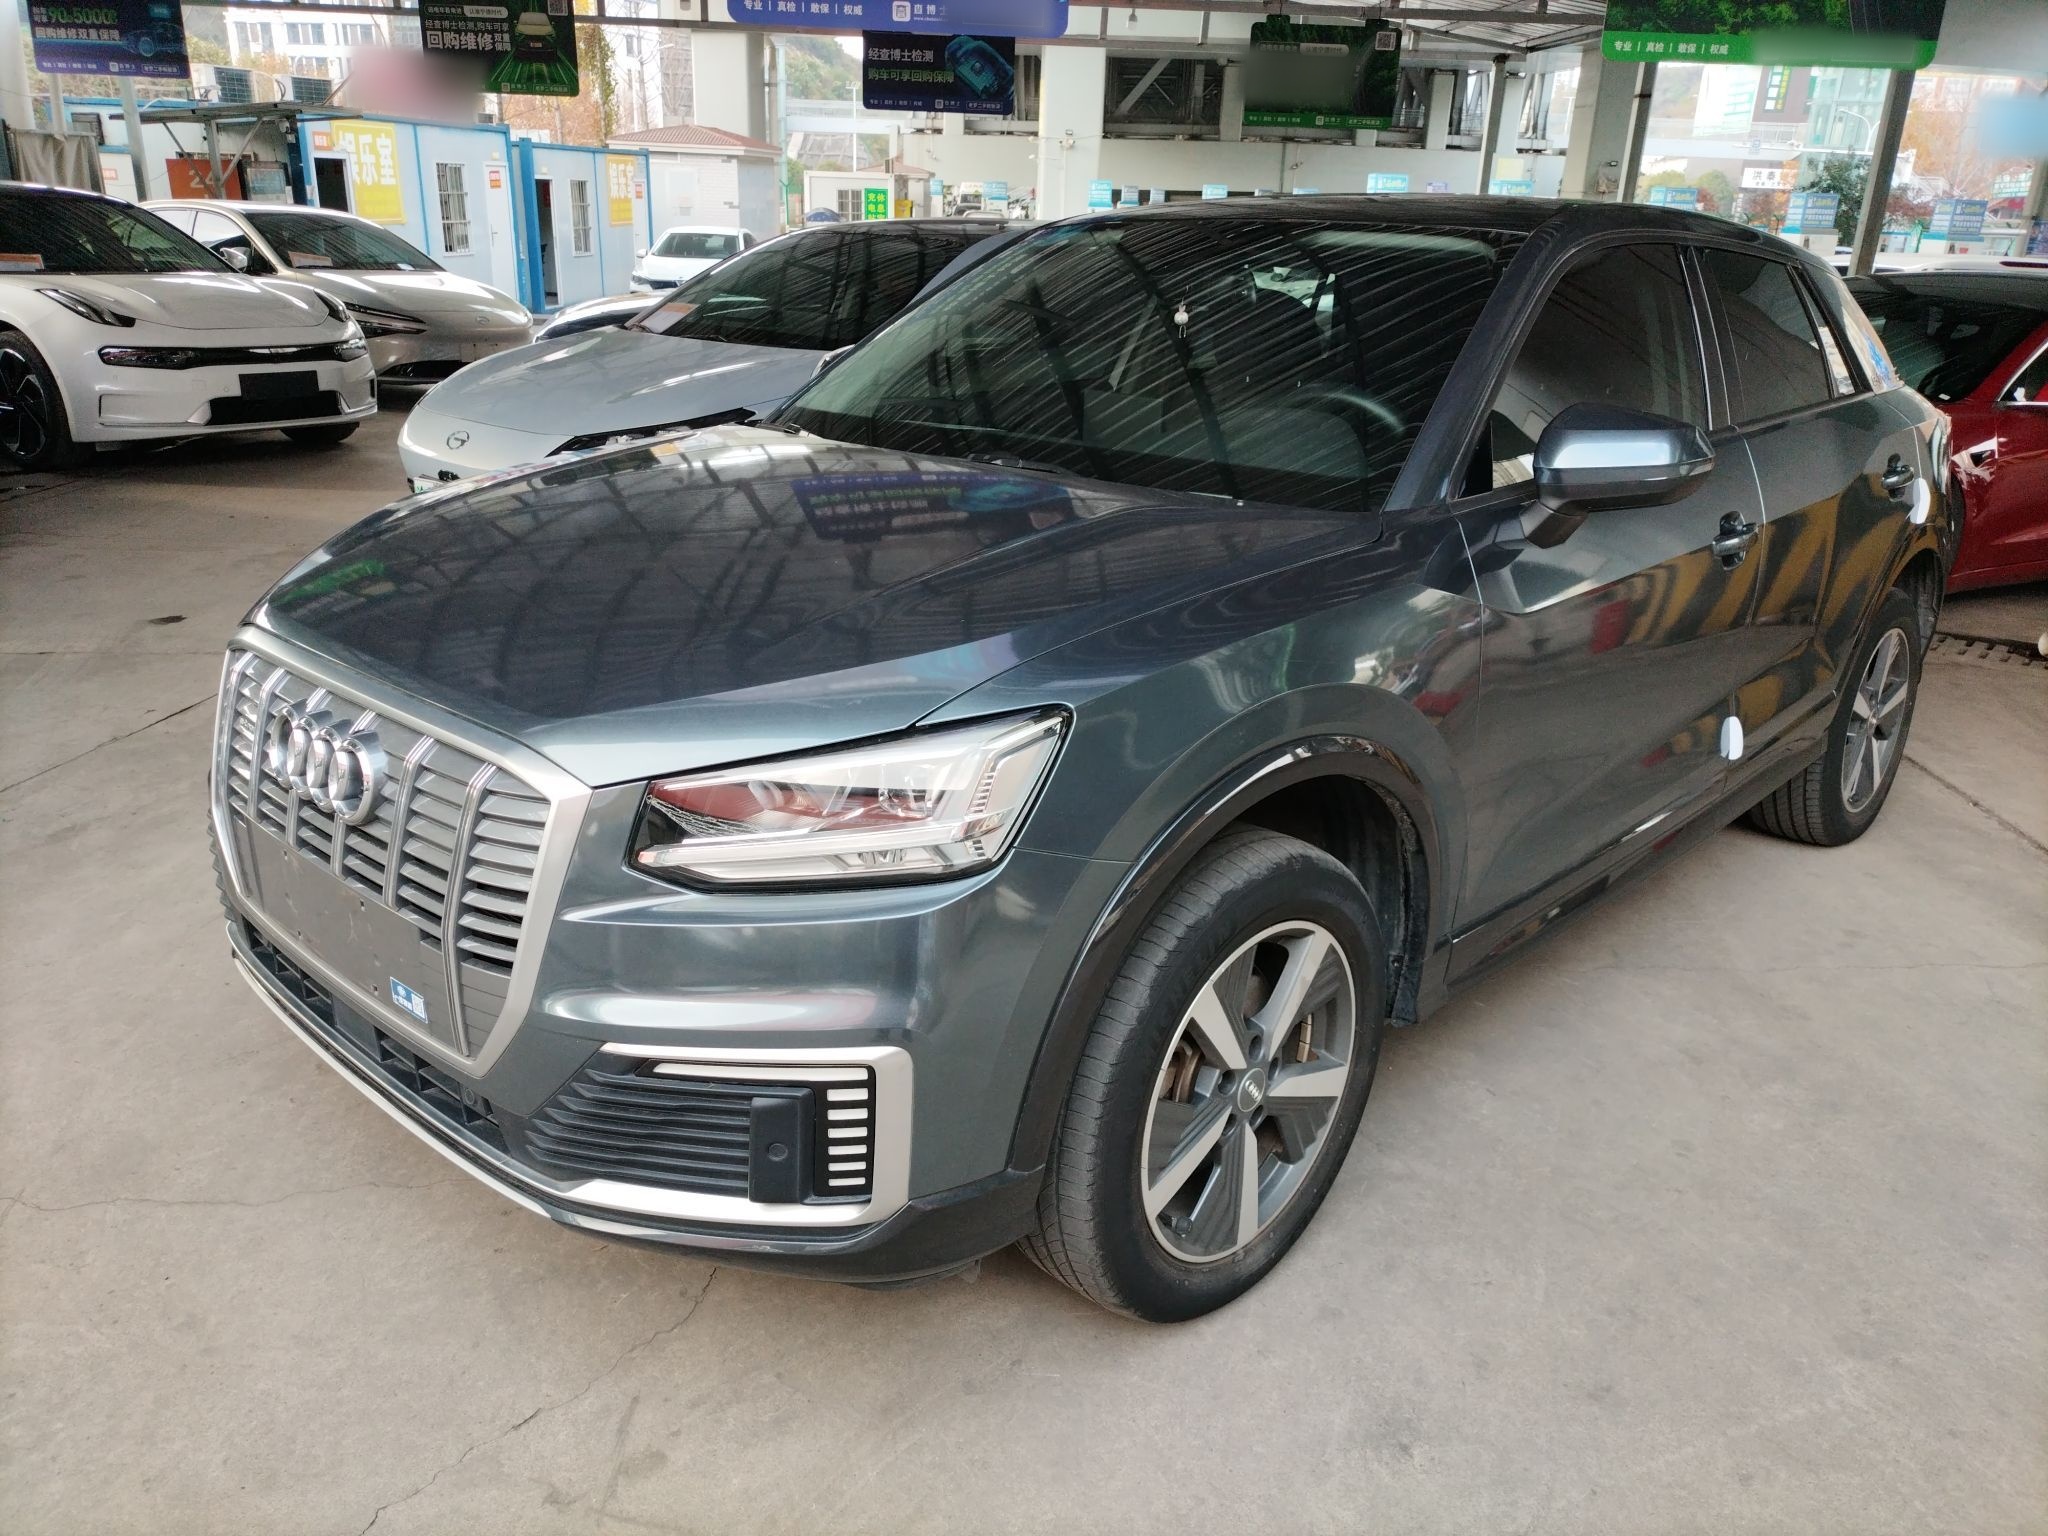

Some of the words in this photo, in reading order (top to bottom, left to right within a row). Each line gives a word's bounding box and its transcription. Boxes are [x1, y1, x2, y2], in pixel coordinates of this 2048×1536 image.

[744, 0, 763, 10] 专业
[777, 1, 796, 13] 真检
[810, 3, 830, 14] 敢保
[843, 5, 863, 15] 权威
[426, 31, 494, 51] 回购维修
[1614, 41, 1632, 52] 专业
[1646, 42, 1664, 53] 真检
[1678, 43, 1697, 54] 敢保
[1710, 44, 1729, 55] 权威
[868, 47, 934, 63] 经查博士检测
[868, 68, 954, 83] 购车可享回购保障
